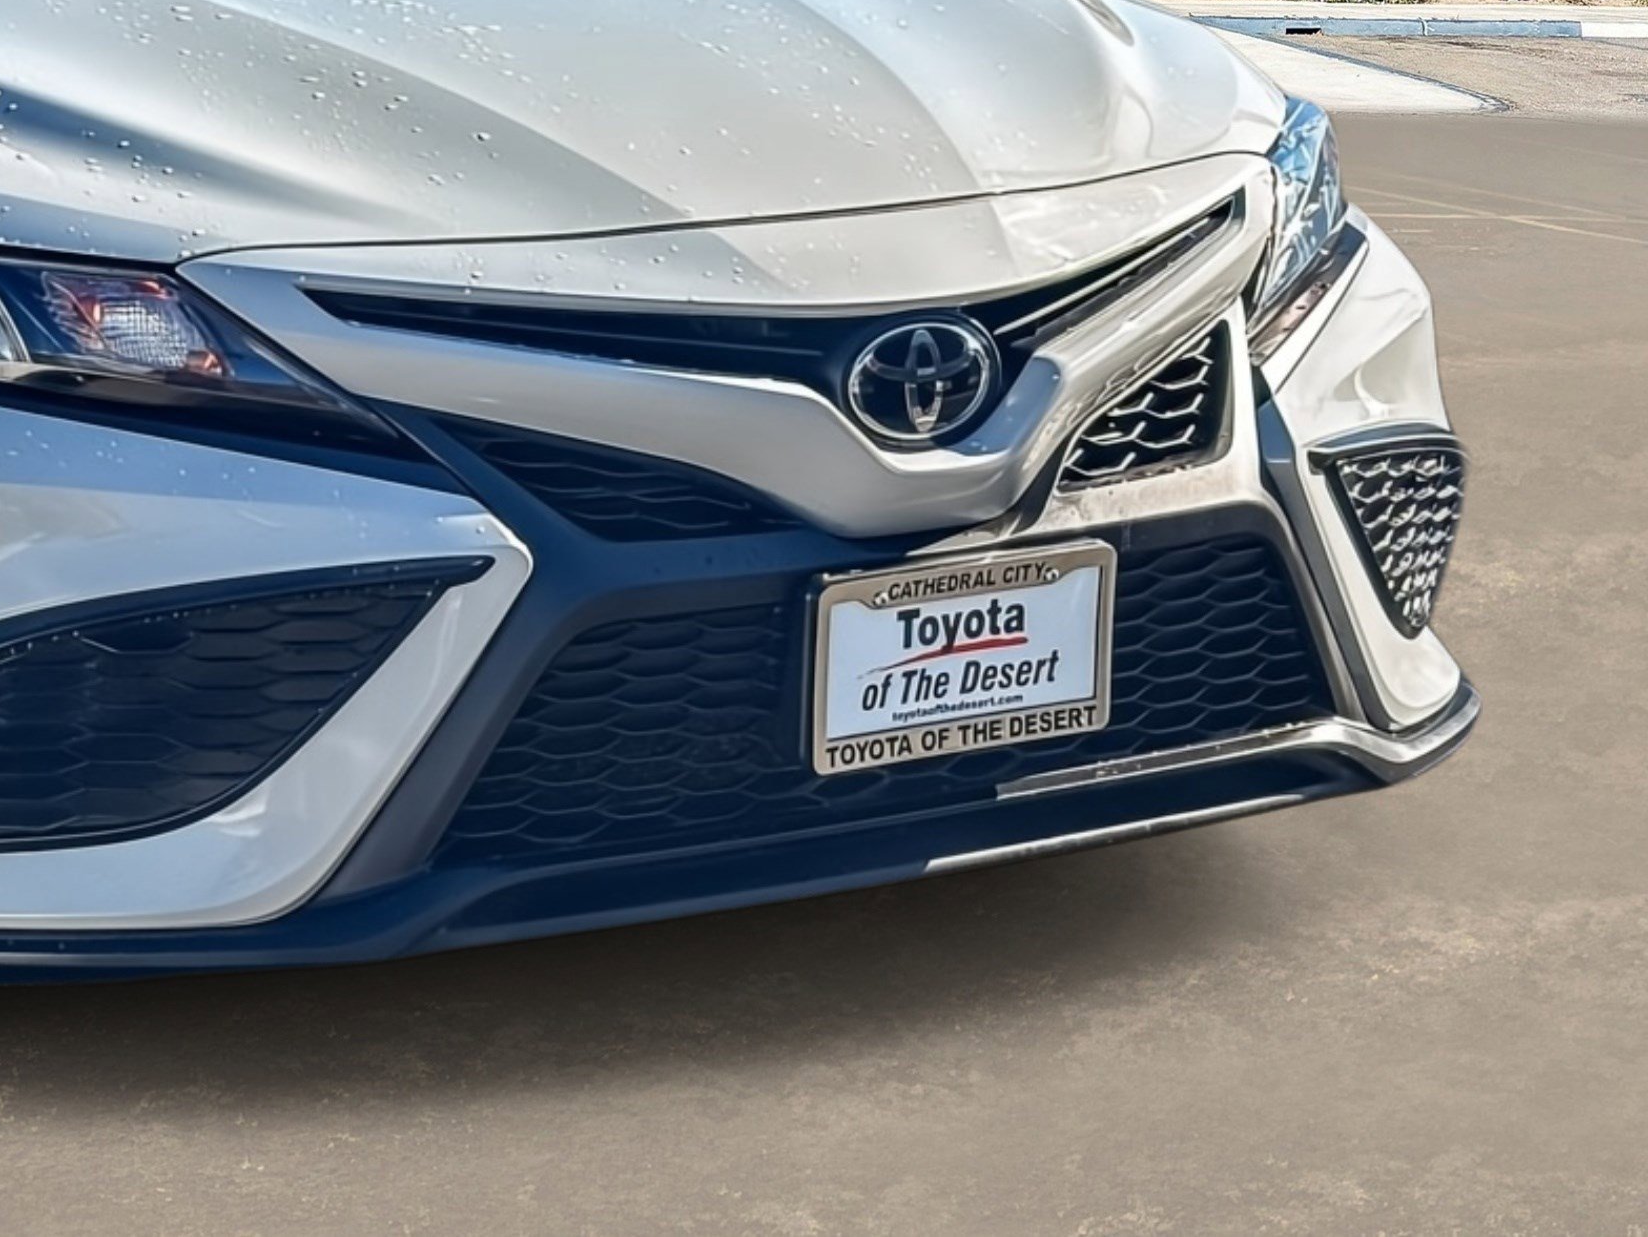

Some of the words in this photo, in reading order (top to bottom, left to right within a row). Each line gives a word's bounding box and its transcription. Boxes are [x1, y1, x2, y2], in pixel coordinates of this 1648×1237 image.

[888, 566, 997, 601] CATHEDRAL
[1002, 561, 1047, 584] CITY
[897, 598, 1025, 650] Toyota
[861, 673, 893, 711] of
[901, 669, 951, 707] The
[959, 649, 1060, 695] Desert
[826, 734, 913, 769] TOYOTA
[921, 726, 951, 751] OF
[957, 719, 1003, 747] THE
[1008, 705, 1098, 739] DESERT
